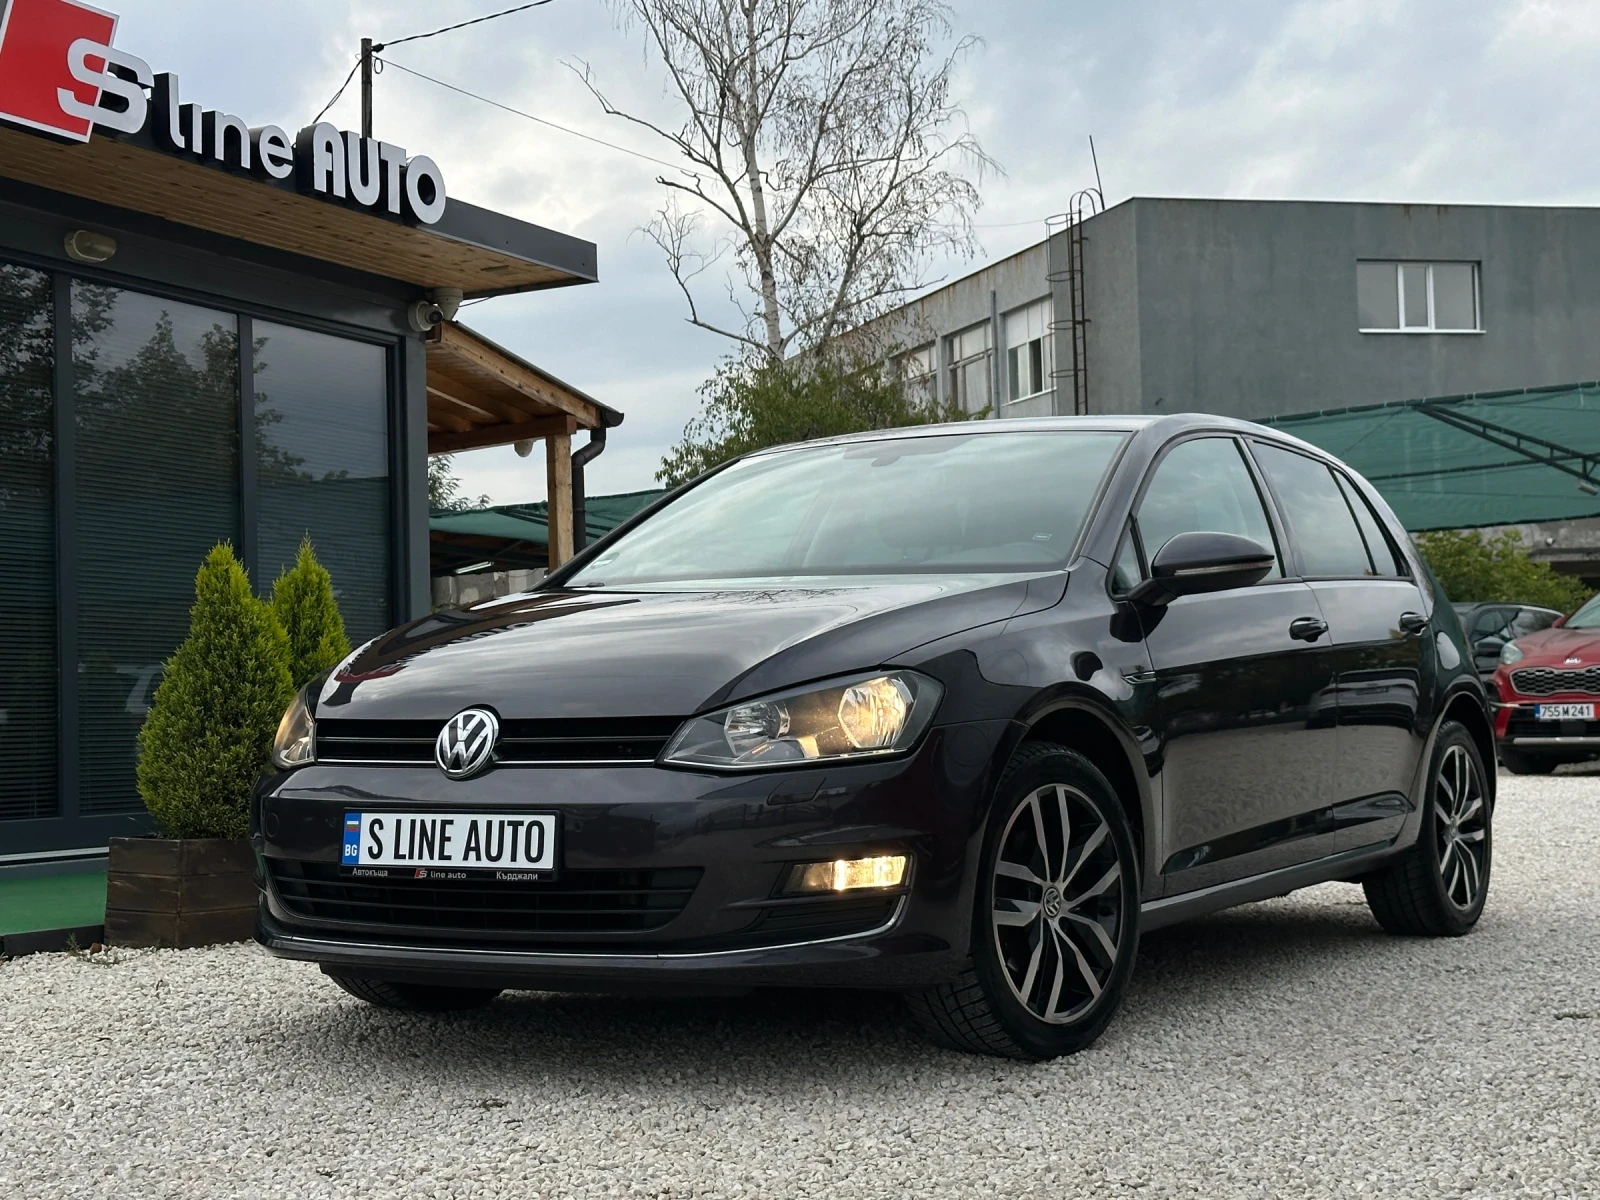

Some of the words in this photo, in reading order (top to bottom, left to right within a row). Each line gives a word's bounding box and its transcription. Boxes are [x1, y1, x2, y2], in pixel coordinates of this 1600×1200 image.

[57, 38, 155, 134] S
[168, 72, 293, 179] line
[312, 121, 446, 225] AUTO
[437, 709, 496, 775] VW
[367, 818, 384, 860] S
[393, 818, 454, 861] LINE
[462, 819, 545, 863] AUTO
[344, 844, 358, 857] BG
[352, 867, 388, 878] Автокъща
[430, 870, 446, 879] line
[447, 872, 467, 880] auto
[496, 871, 538, 881] Кърджали
